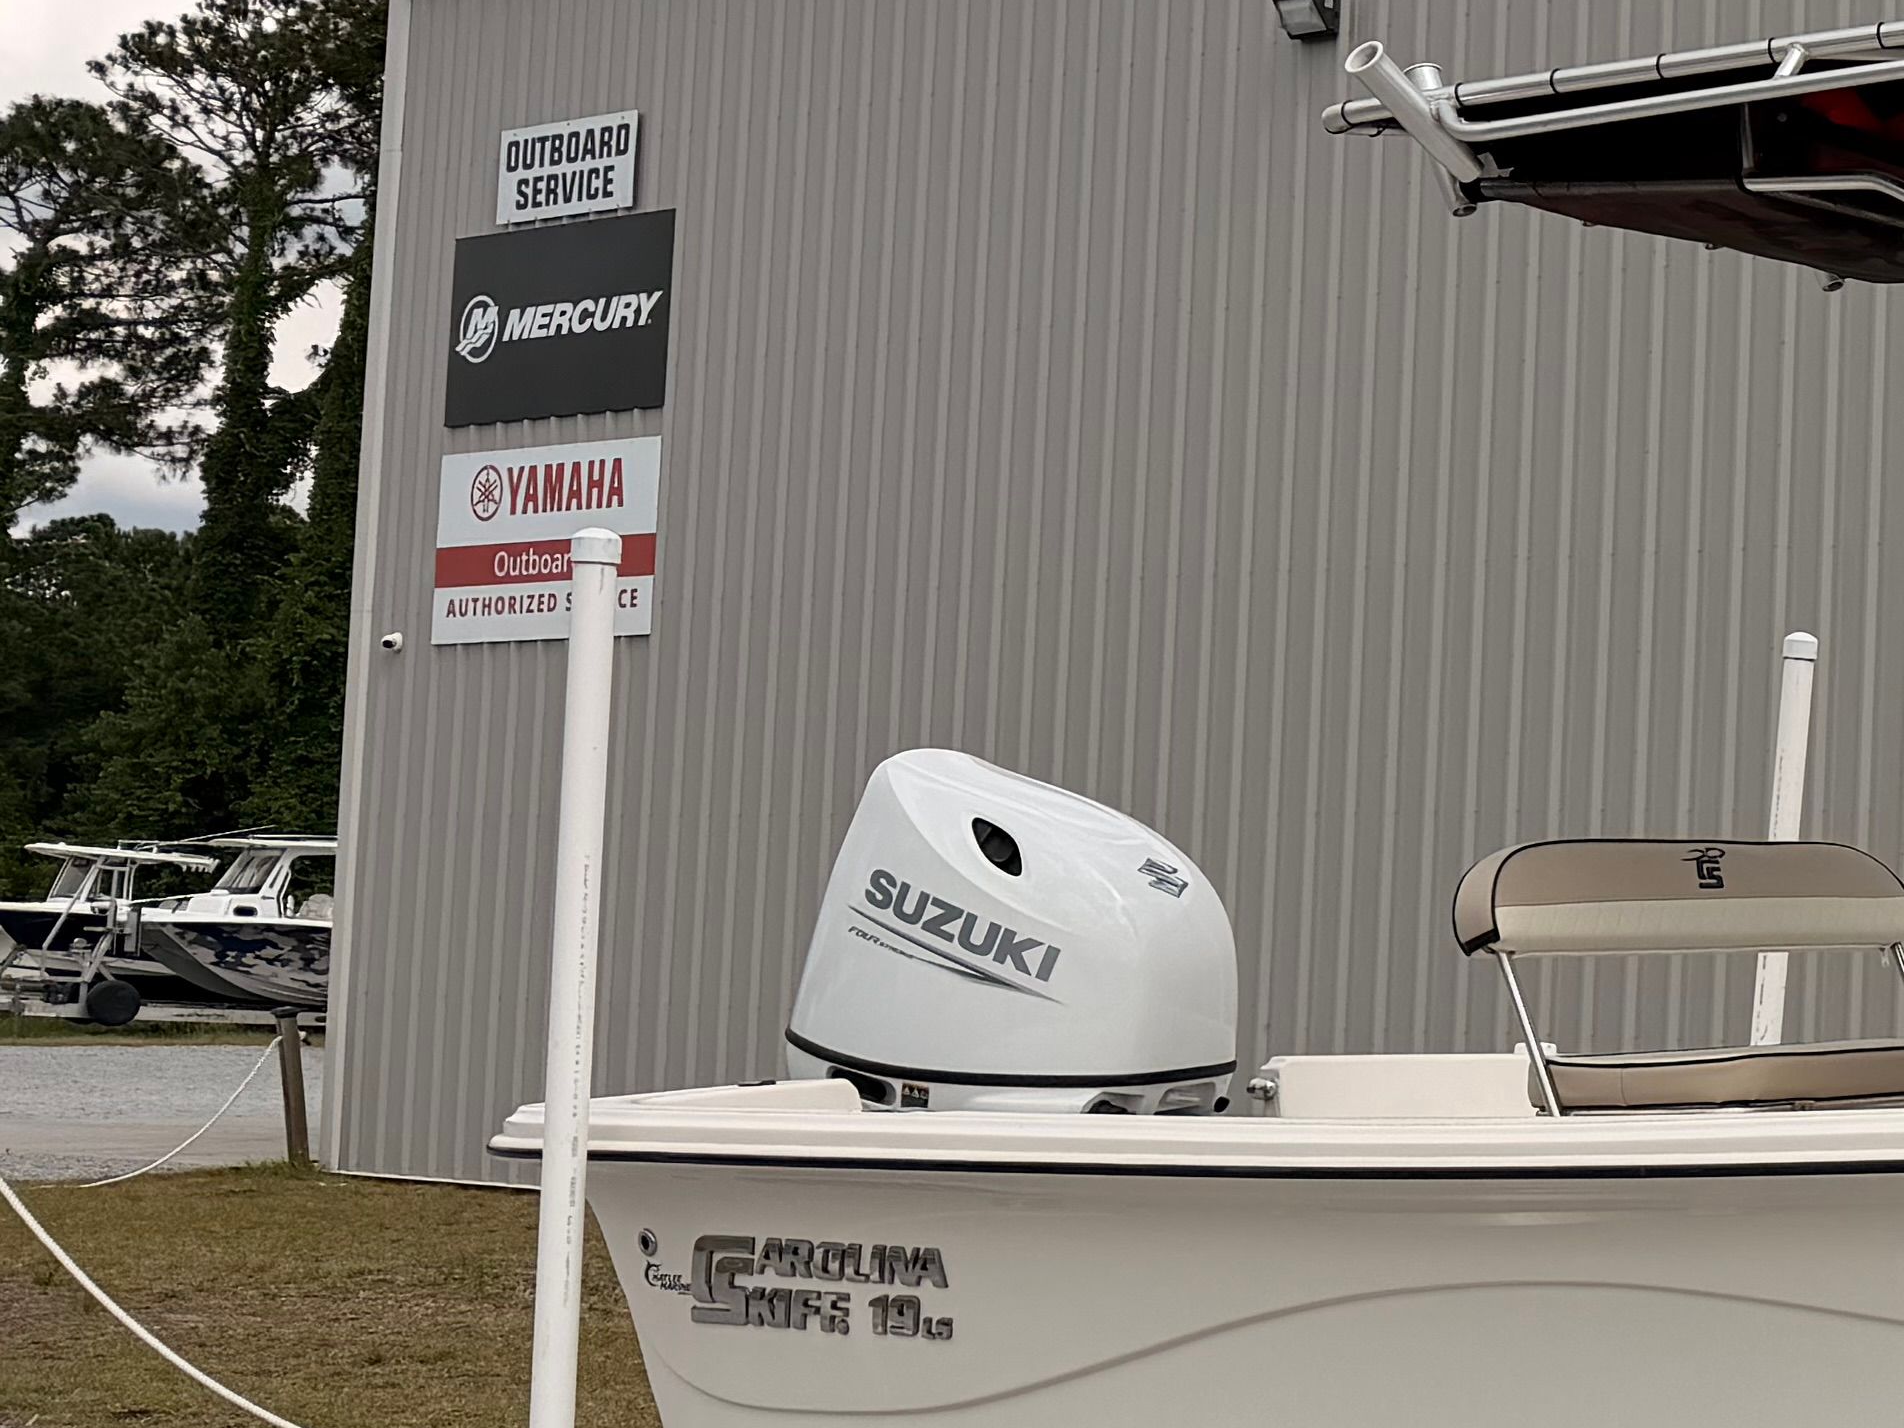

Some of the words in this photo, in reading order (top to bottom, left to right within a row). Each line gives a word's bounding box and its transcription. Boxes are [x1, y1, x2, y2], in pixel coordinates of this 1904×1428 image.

[506, 123, 631, 172] OUTBOARD
[515, 165, 615, 210] SERVICE
[502, 290, 664, 342] MERCURY
[507, 457, 624, 515] YAMAHA
[494, 548, 573, 577] Outboar
[446, 593, 558, 618] AUTHORIZED
[865, 868, 1062, 983] SUZUKI
[691, 1234, 949, 1303] CAROLINA
[868, 1293, 921, 1337] 19
